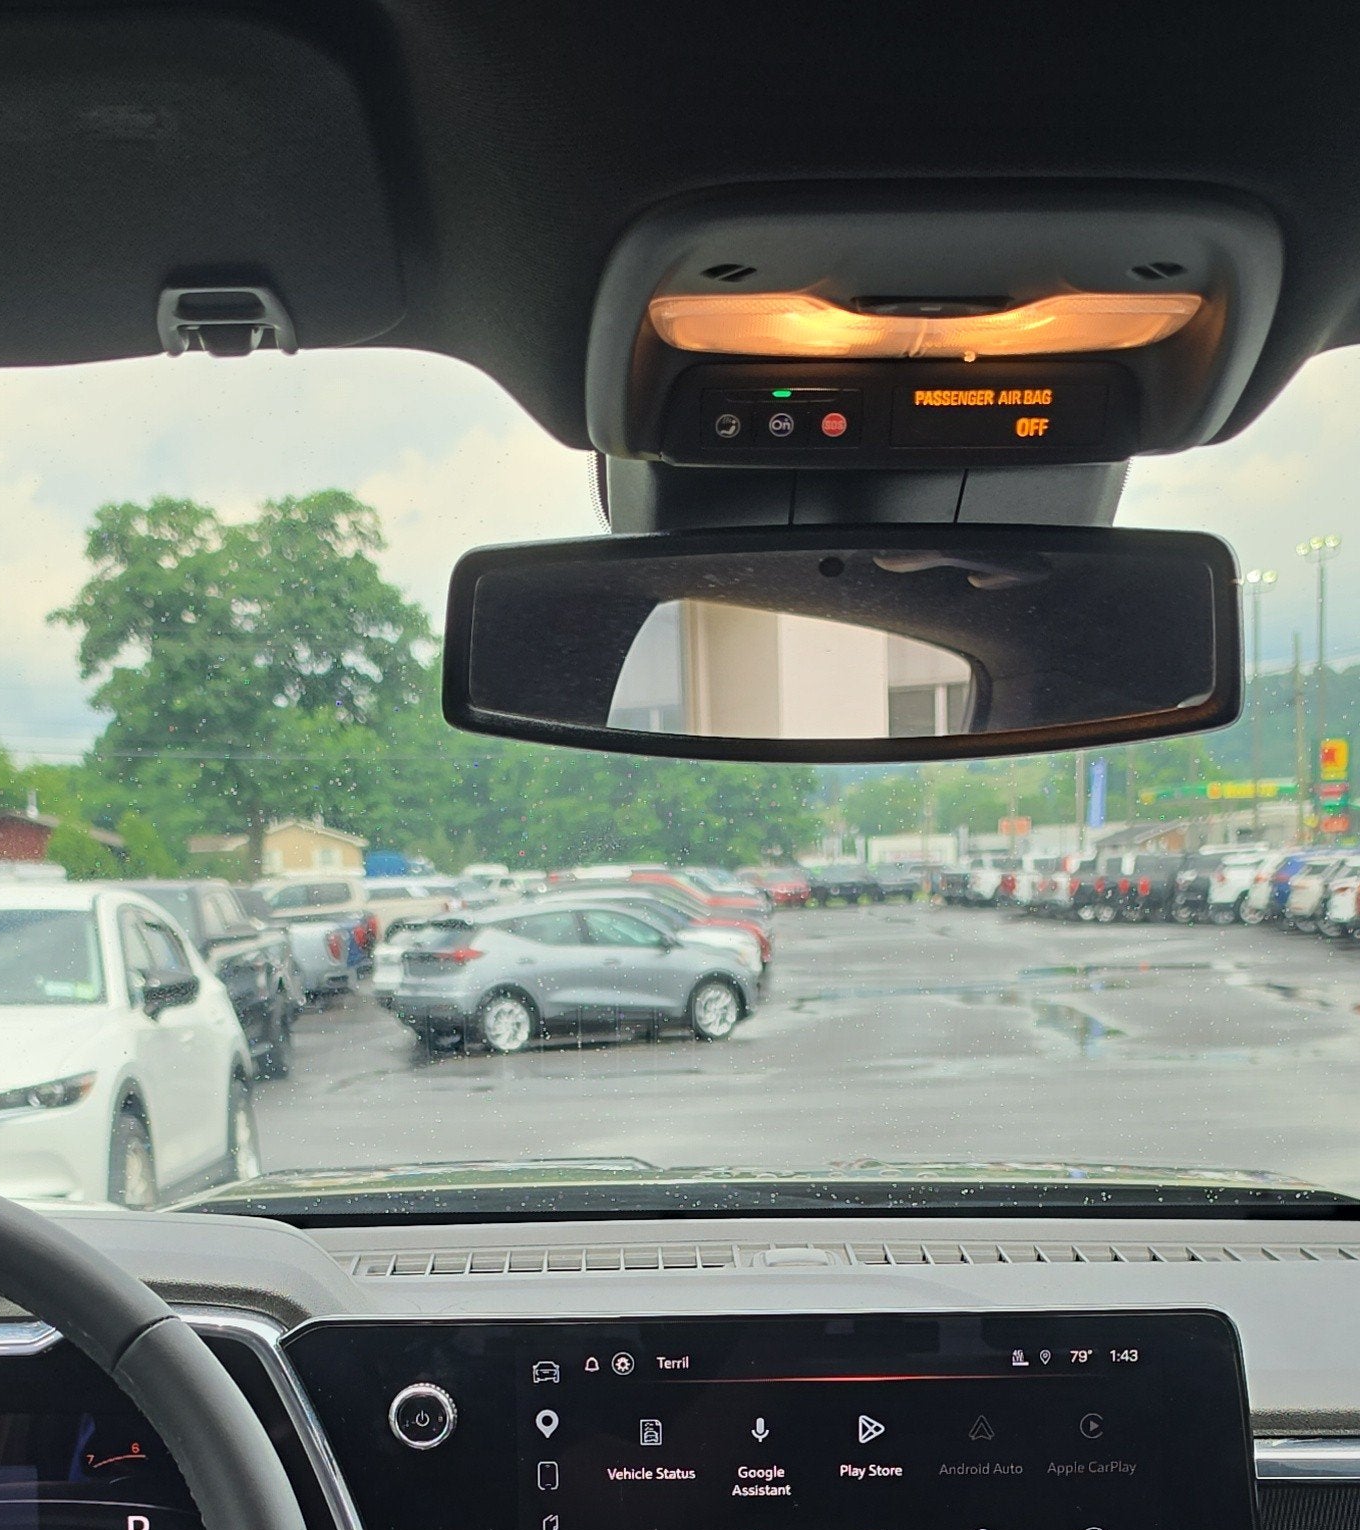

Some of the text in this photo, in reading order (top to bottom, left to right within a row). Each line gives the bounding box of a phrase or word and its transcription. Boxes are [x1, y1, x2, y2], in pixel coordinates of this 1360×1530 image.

[914, 388, 1053, 406] PASSENGER AIR BAG
[822, 419, 846, 431] SOS
[1014, 417, 1050, 437] OFF
[656, 1355, 690, 1370] Terril
[1109, 1349, 1139, 1363] 1:43
[131, 1442, 140, 1453] 6
[85, 1454, 95, 1464] 7
[606, 1467, 696, 1481] Vehicle Status
[737, 1465, 786, 1482] Google
[840, 1464, 903, 1480] Play Store
[939, 1461, 1024, 1475] Android Auto
[1047, 1459, 1138, 1476] Apple CarPlay
[731, 1483, 792, 1497] Assistant
